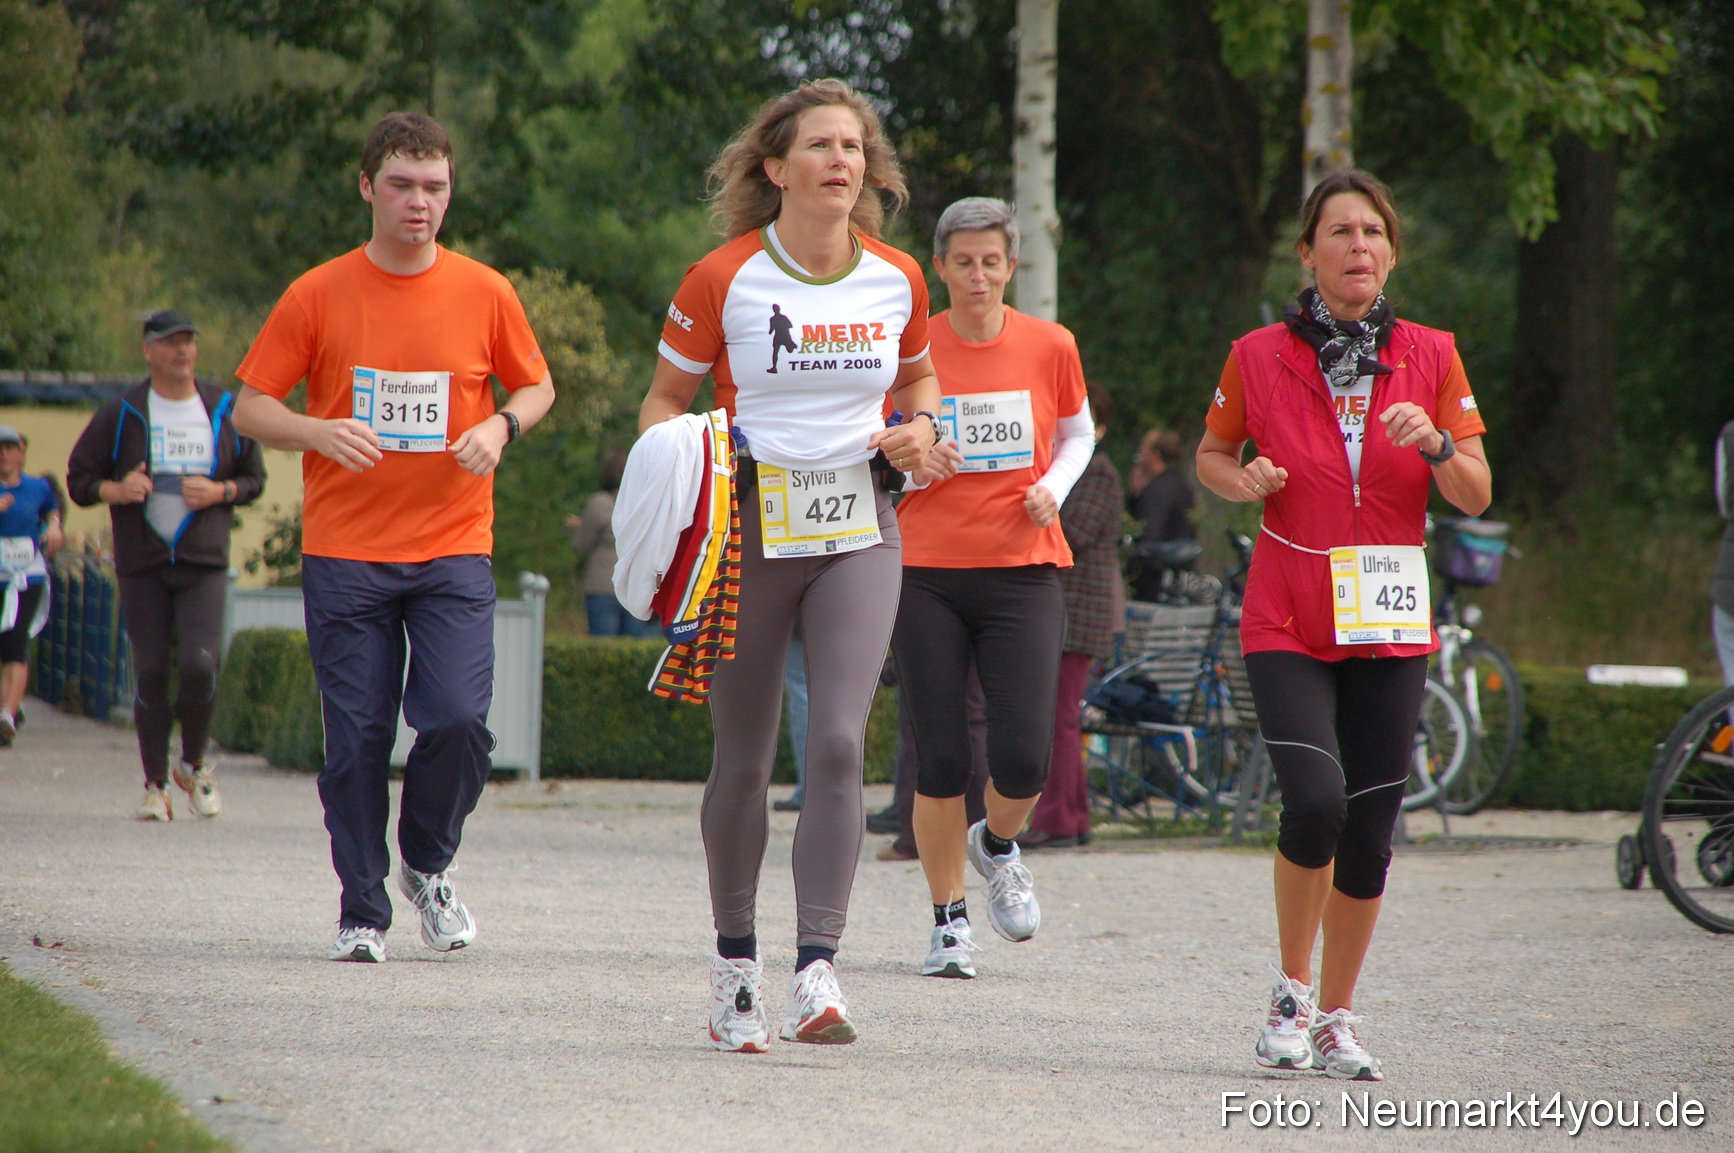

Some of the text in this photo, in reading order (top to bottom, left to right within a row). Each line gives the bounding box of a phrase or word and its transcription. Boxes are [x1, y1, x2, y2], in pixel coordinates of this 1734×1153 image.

[668, 301, 694, 332] ERZ
[802, 322, 887, 343] MERZ
[798, 336, 873, 354] Reisen
[788, 358, 882, 371] TEAM 2008
[381, 378, 438, 395] Ferdinand
[359, 397, 365, 407] D
[962, 402, 995, 416] Beate
[1333, 396, 1367, 415] ME
[1460, 395, 1478, 412] ME
[381, 402, 438, 423] 3115
[966, 421, 1022, 444] 3280
[791, 470, 836, 491] Sylvia
[765, 500, 773, 514] D
[805, 493, 857, 524] 427
[837, 532, 879, 545] PFLEIDERER
[1363, 555, 1400, 573] Ulrike
[1338, 585, 1345, 598] D
[1376, 585, 1416, 612] 425
